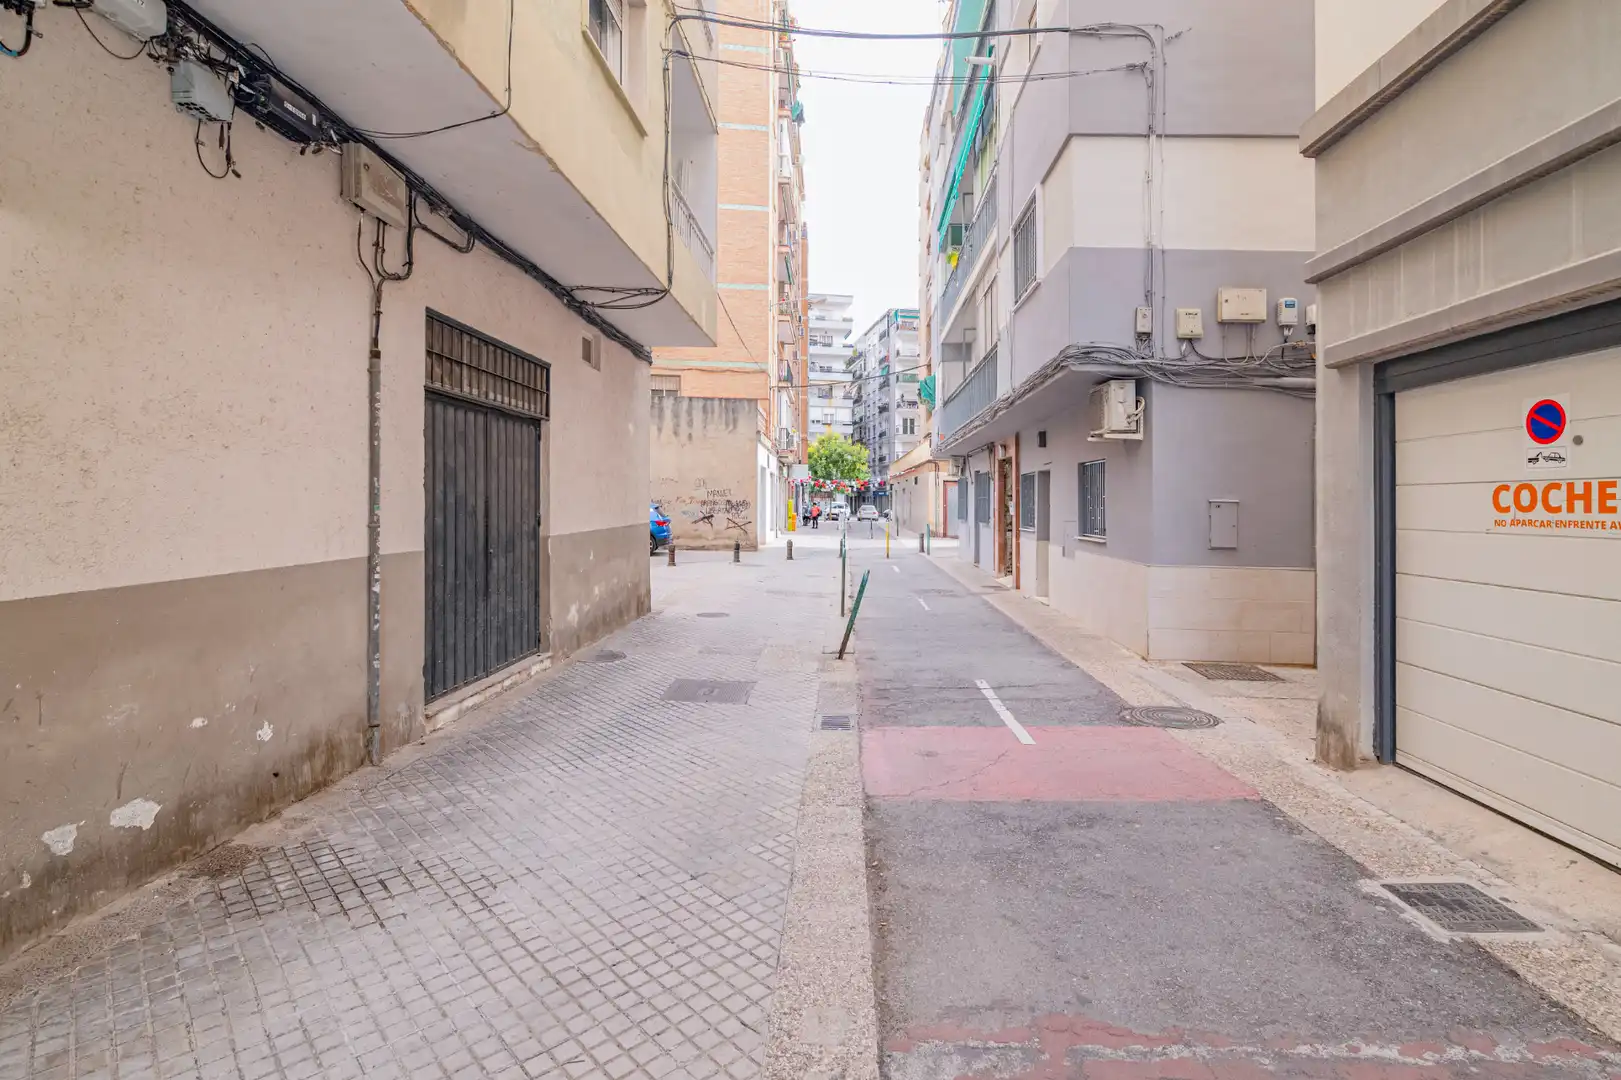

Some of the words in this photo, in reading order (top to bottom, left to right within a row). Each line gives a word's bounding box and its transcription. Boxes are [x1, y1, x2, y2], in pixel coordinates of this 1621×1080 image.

[1494, 519, 1507, 528] NO
[1510, 519, 1552, 529] APARCAR
[1554, 519, 1607, 530] ENFRENTE
